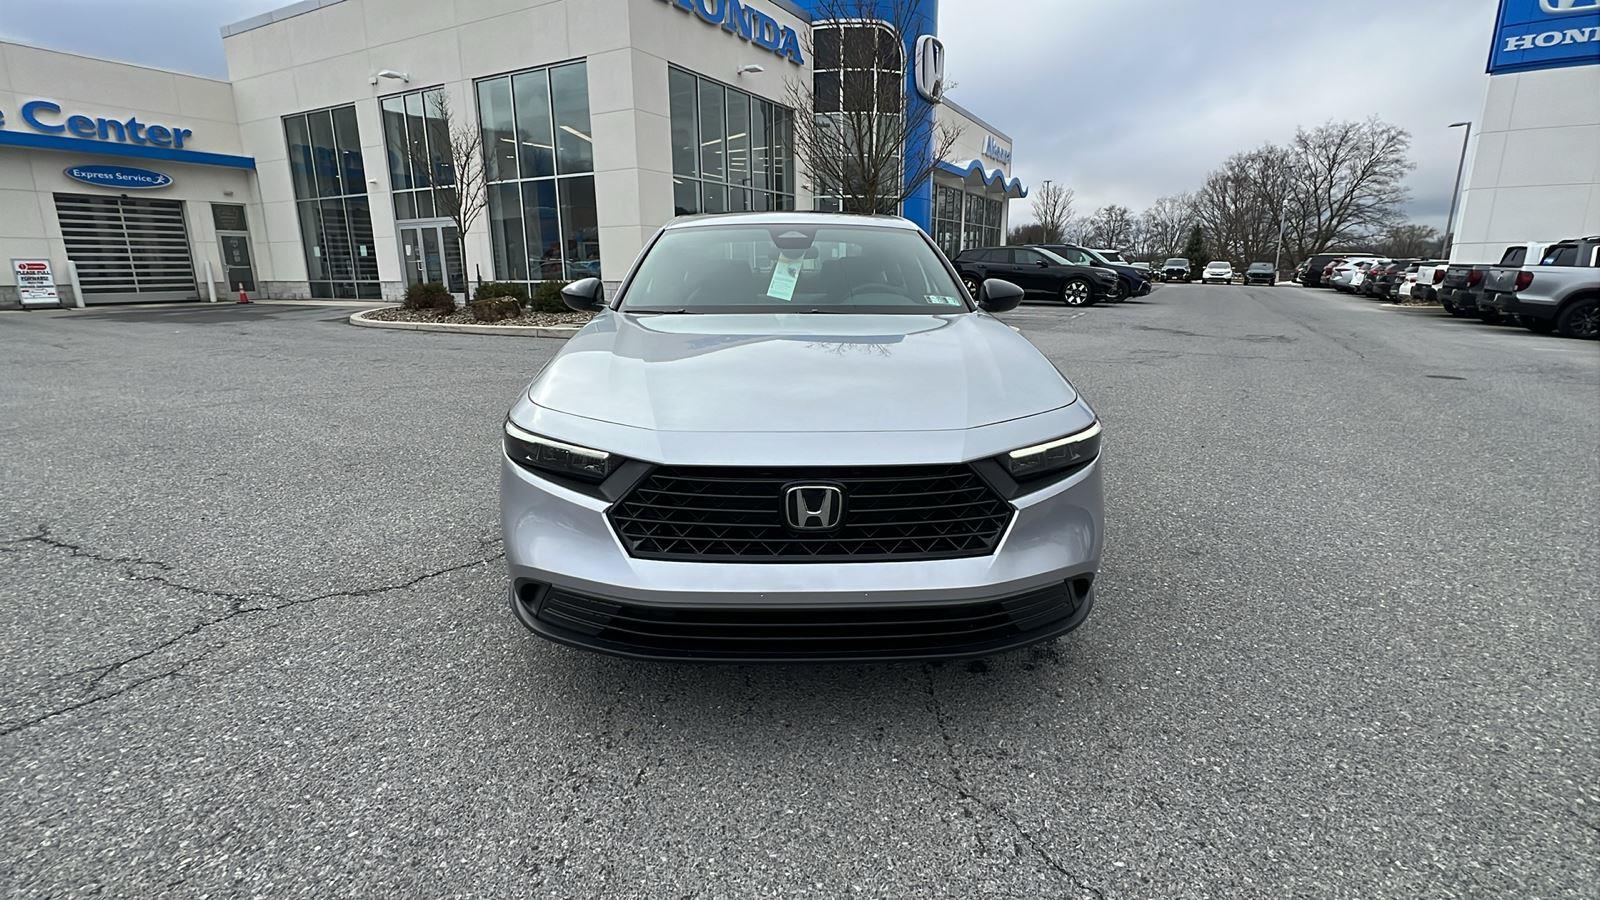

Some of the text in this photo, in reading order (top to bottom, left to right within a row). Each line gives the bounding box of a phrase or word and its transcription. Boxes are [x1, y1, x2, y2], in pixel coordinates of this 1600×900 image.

[658, 0, 805, 65] ONDA
[22, 100, 192, 148] Center
[73, 169, 152, 182] Express Service
